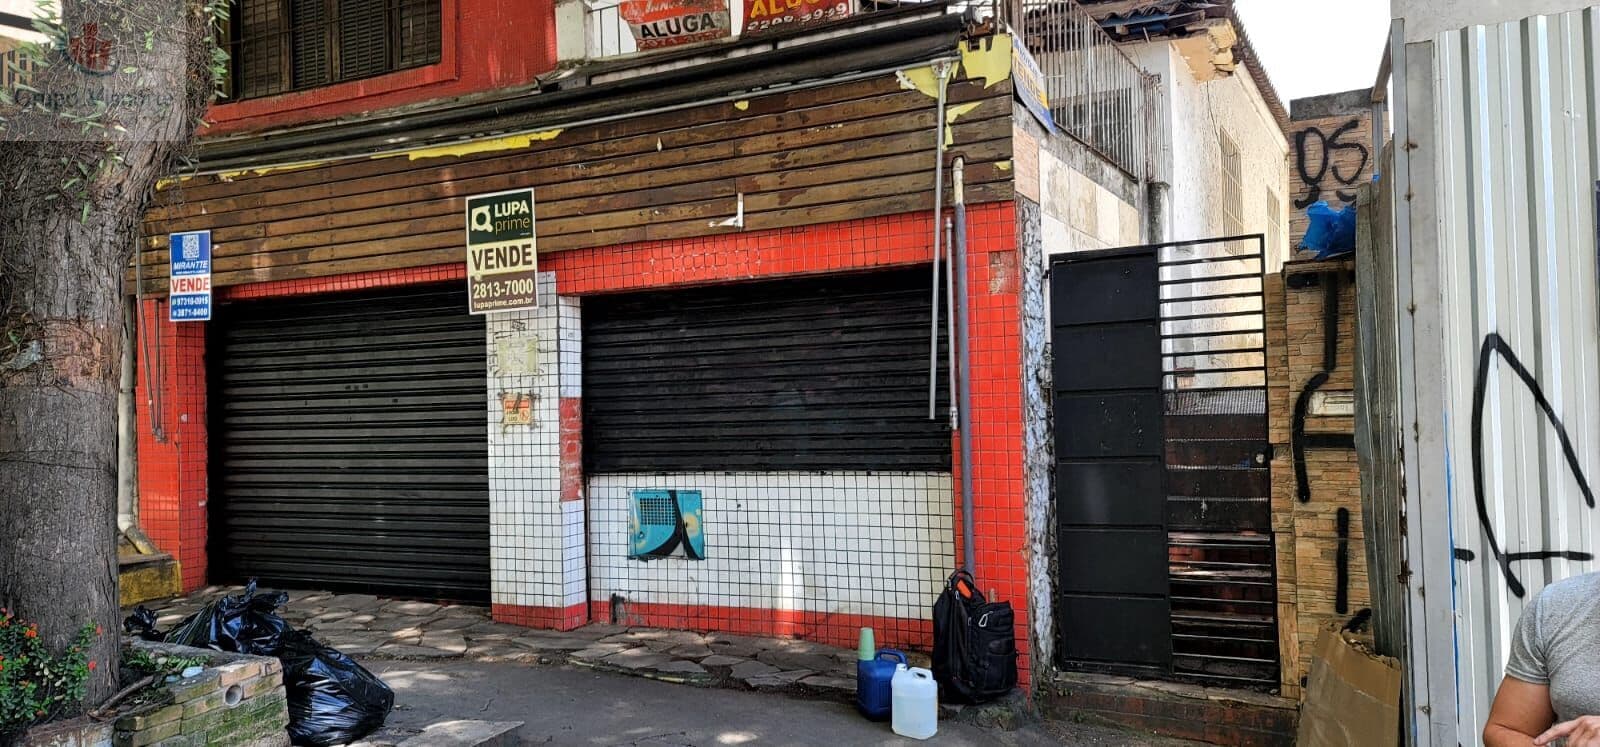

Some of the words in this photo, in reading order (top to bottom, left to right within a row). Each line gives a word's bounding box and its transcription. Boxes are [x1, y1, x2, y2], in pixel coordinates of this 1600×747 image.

[750, 0, 820, 18] ALU
[640, 13, 716, 38] ALUGA
[494, 200, 530, 218] LUPA
[495, 217, 531, 236] prime
[173, 260, 208, 270] MIRANTTE
[472, 243, 533, 271] VENDE
[172, 277, 209, 293] VENDE
[473, 278, 534, 299] 2813-7000
[473, 296, 533, 310] lupaprime.com.br
